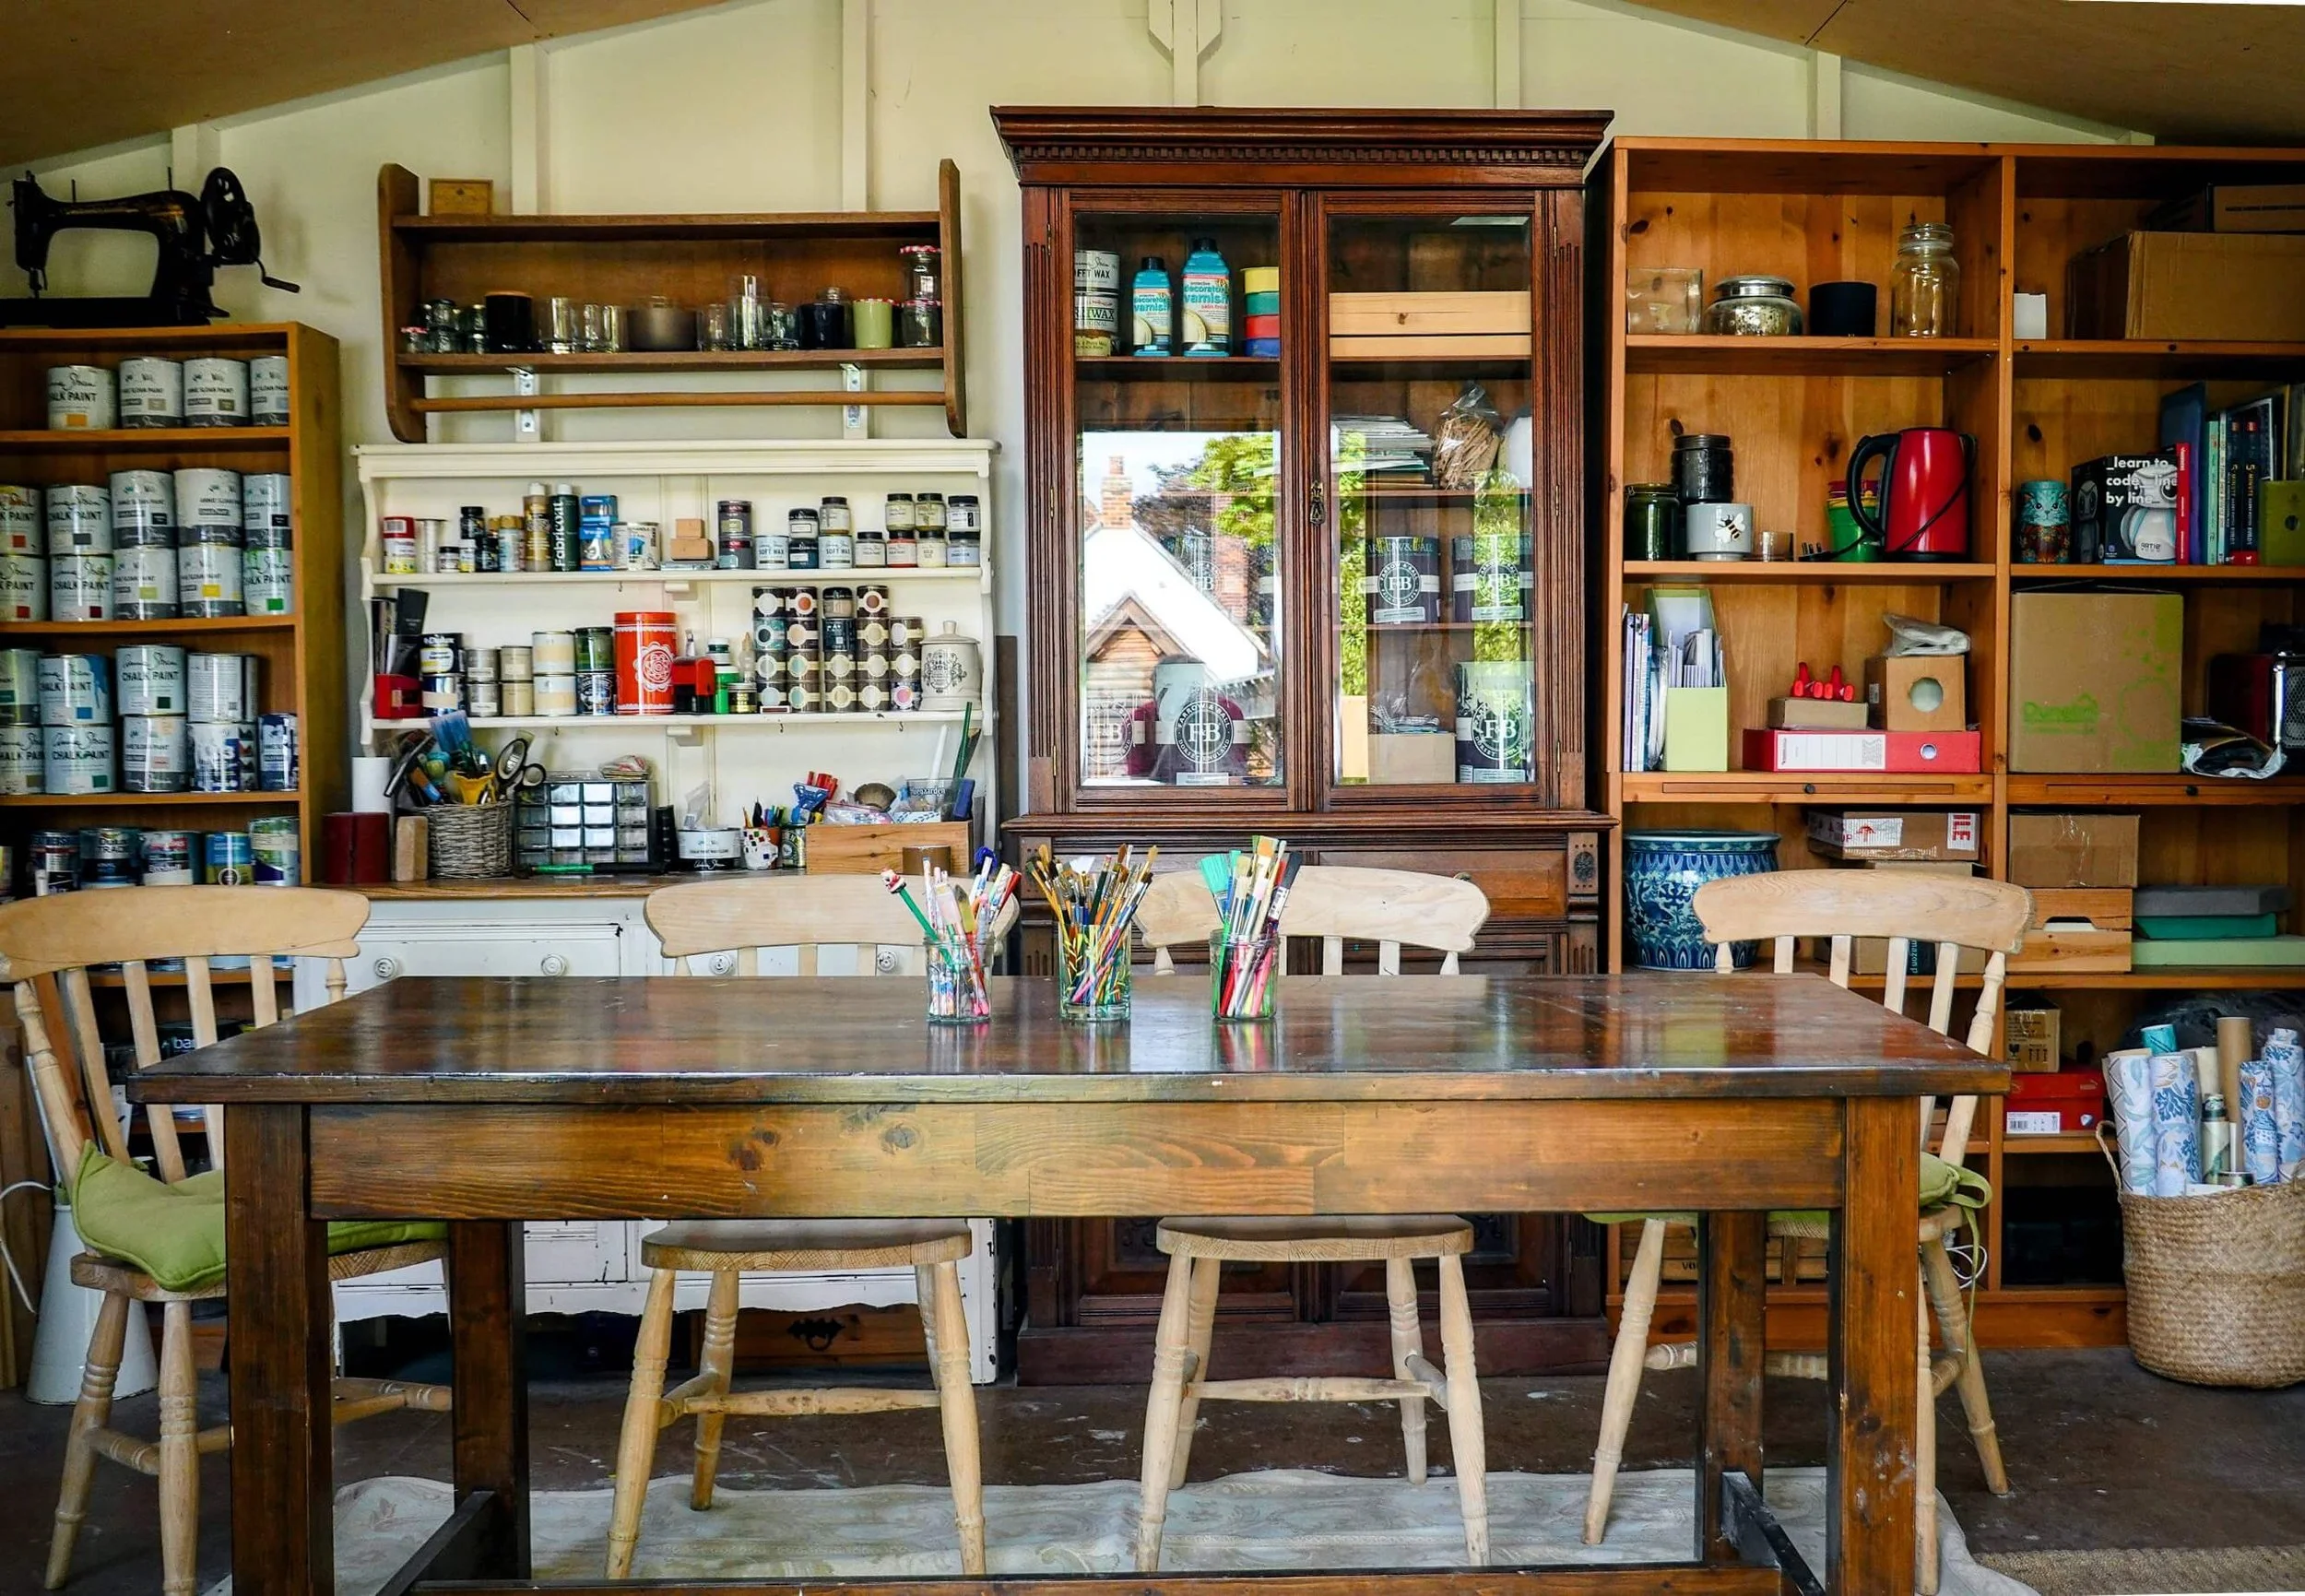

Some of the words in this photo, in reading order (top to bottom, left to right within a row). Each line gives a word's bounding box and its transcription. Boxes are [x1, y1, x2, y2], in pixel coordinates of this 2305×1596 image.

[1093, 269, 1110, 278] WAX
[1185, 292, 1229, 304] varnish
[1134, 303, 1170, 312] varnish
[67, 392, 98, 403] PAINT
[2154, 457, 2169, 468] to
[2106, 491, 2124, 507] by
[9, 511, 35, 522] PAINT
[9, 581, 35, 591] PAINT
[152, 670, 179, 680] PAINT
[1177, 703, 1206, 728] FARROW
[1215, 707, 1231, 728] BALL
[1909, 939, 1919, 967] mazon
